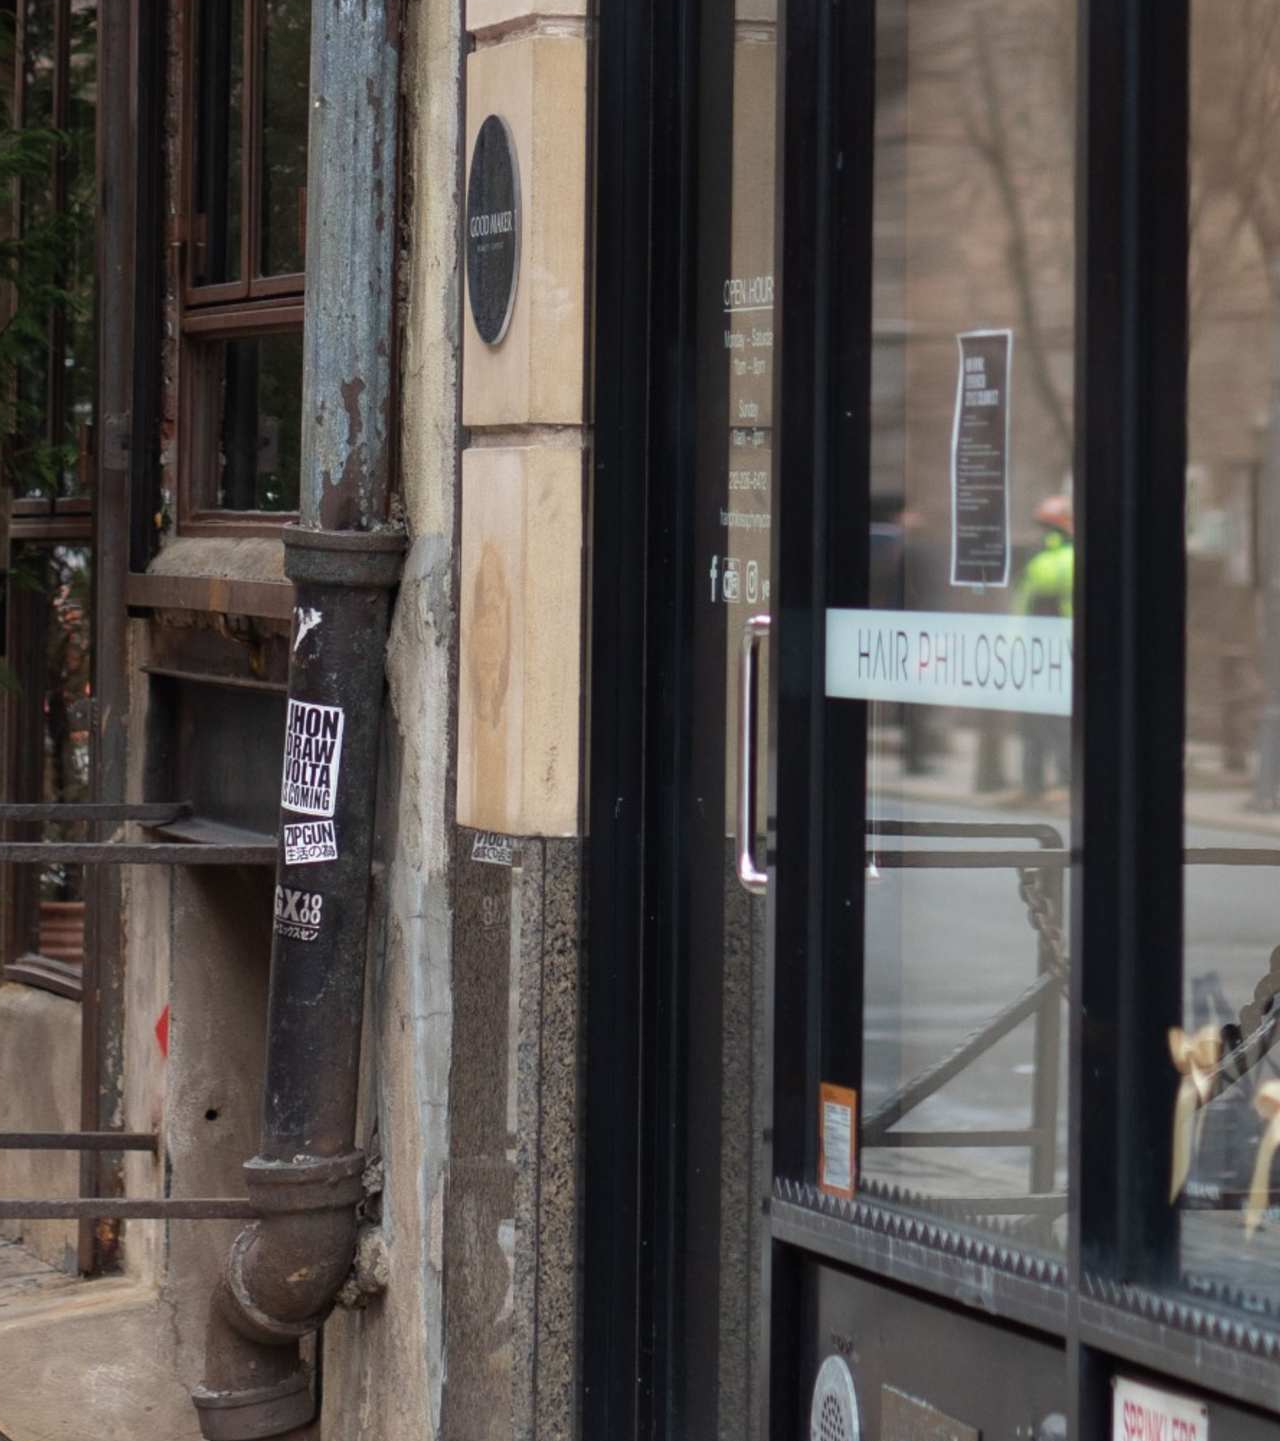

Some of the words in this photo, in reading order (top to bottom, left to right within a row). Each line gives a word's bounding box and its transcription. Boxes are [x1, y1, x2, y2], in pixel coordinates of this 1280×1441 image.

[750, 276, 774, 305] HOUR
[857, 628, 909, 682] HAIR
[919, 630, 1072, 694] PHILOSOPH
[284, 757, 331, 789] VOLTA
[288, 784, 330, 811] COMING
[285, 822, 334, 847] ZIPGUN
